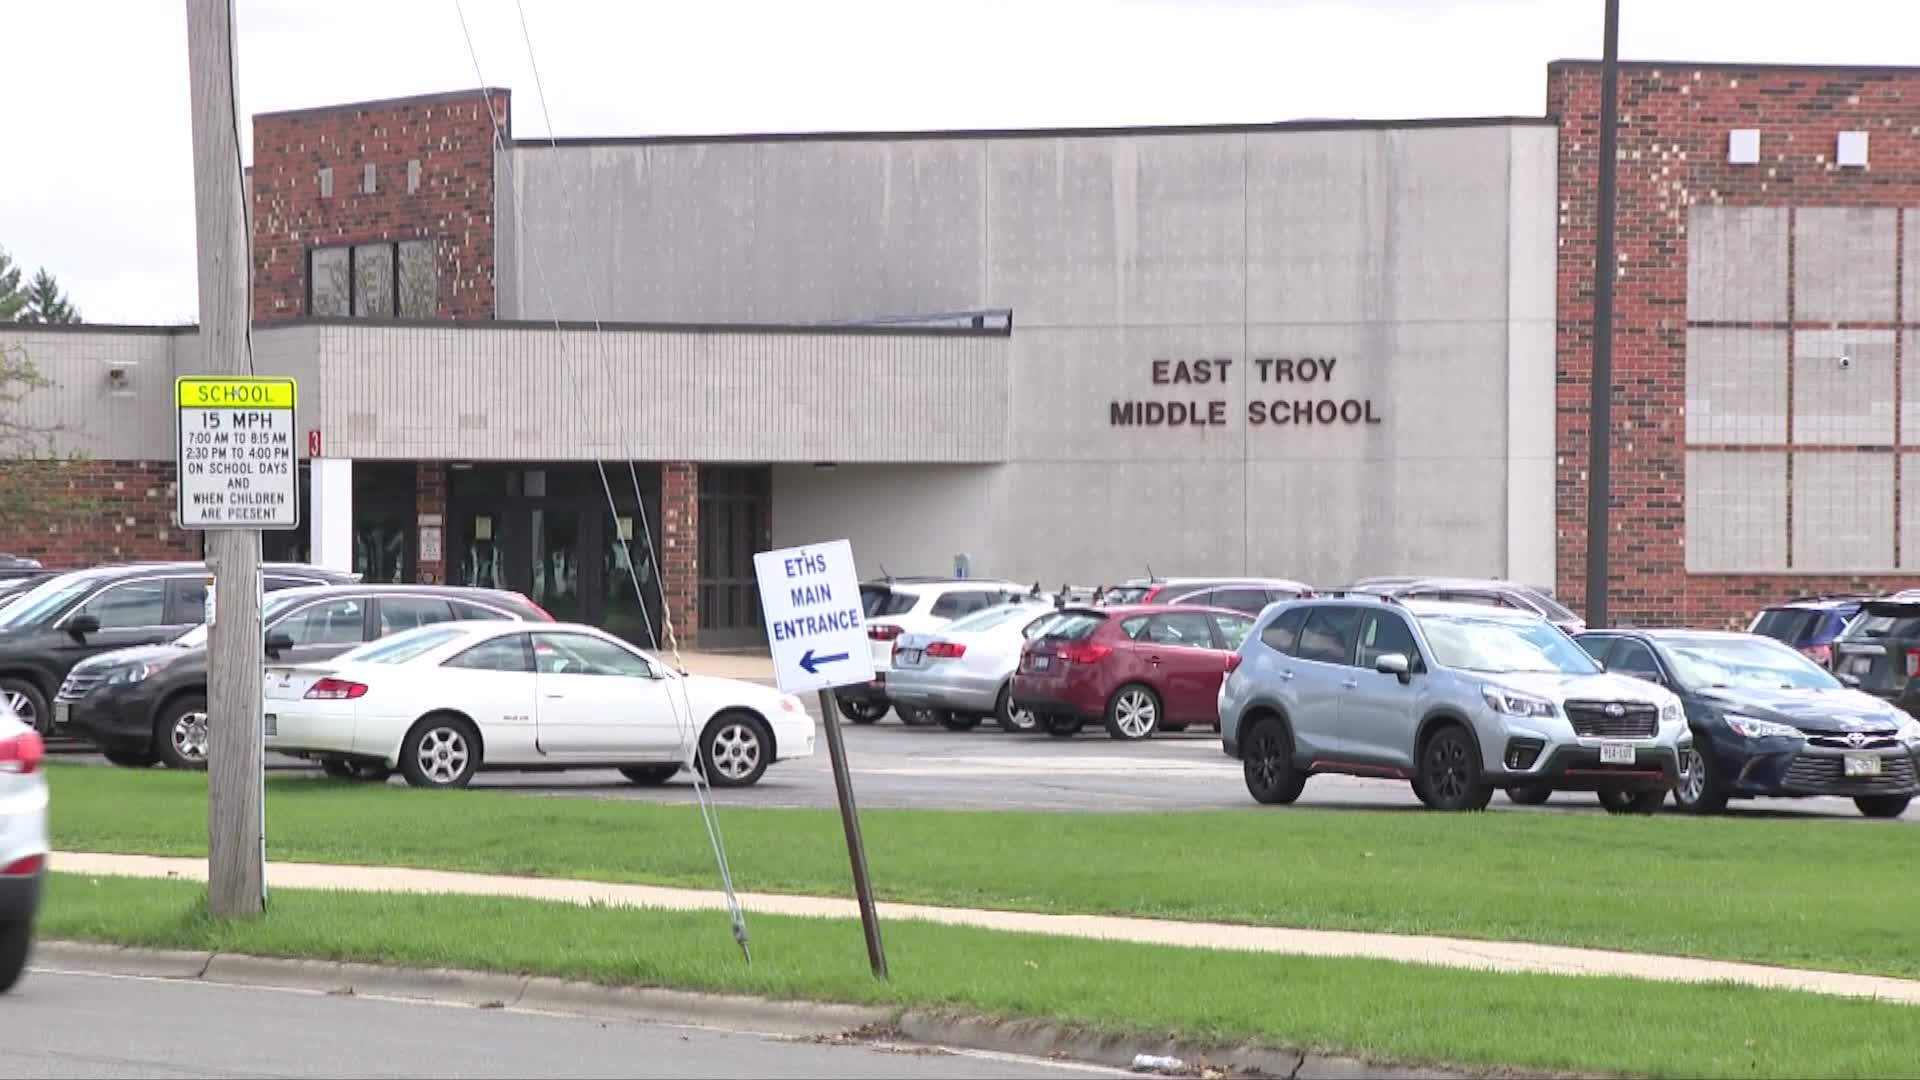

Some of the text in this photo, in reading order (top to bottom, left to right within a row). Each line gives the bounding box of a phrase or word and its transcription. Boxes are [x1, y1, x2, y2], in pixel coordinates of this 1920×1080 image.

[1152, 358, 1336, 385] EAST TROY
[198, 385, 274, 402] SCHOOL
[202, 412, 272, 429] 15 MPH
[1110, 399, 1381, 426] MIDDLE SCHOOL
[189, 432, 211, 444] 7:00
[214, 432, 229, 444] AM
[234, 432, 246, 444] TO
[272, 432, 286, 444] AM
[311, 432, 319, 456] 3
[186, 447, 208, 459] 2:30
[211, 447, 226, 459] PM
[232, 447, 243, 459] TO
[274, 447, 289, 459] PM
[188, 462, 287, 474] ON SCHOOL DAYS
[227, 478, 250, 489] AND
[193, 493, 284, 504] WHEN CHILDREN
[201, 508, 277, 519] ARE PRESENT
[784, 553, 826, 578] ETHS
[791, 583, 832, 607] MAIN
[773, 608, 860, 641] ENTRANCE
